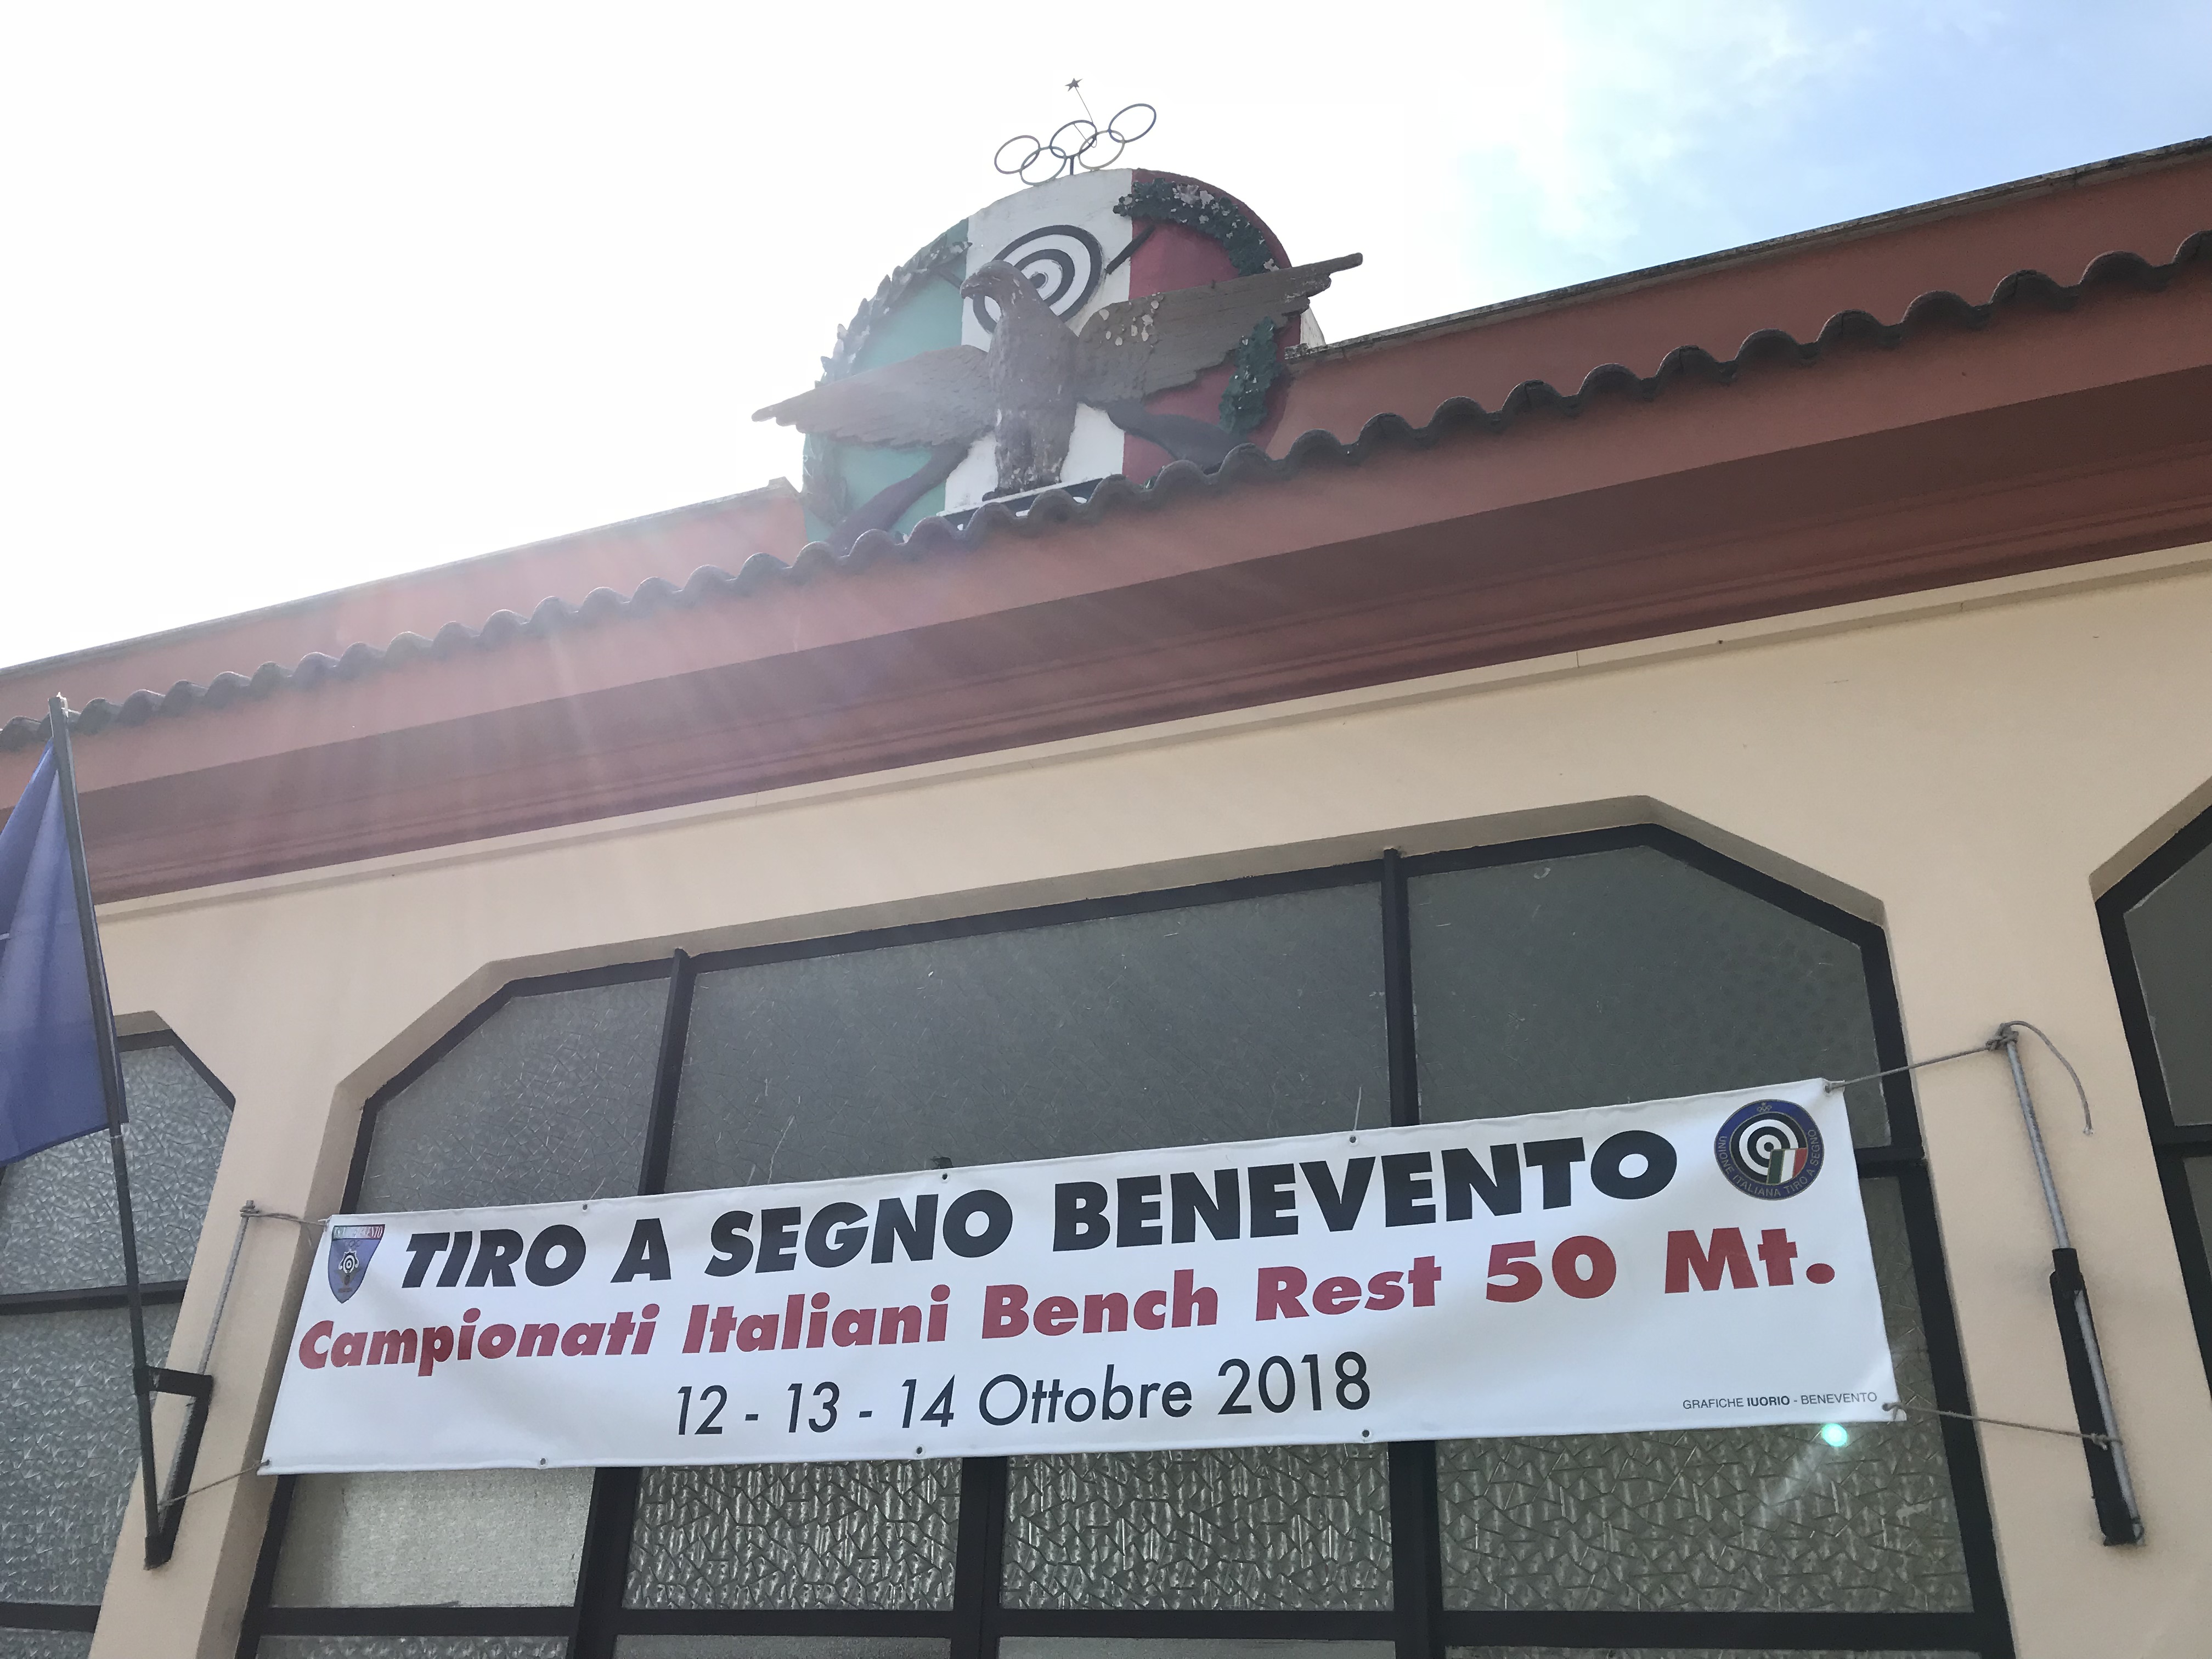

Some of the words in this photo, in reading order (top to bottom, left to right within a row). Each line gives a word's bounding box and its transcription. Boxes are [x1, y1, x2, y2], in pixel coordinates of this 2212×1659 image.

[1718, 1136, 1734, 1174] UNIONE
[1808, 1129, 1820, 1166] SEGNO
[1733, 1174, 1781, 1197] ITALIANA
[1784, 1176, 1808, 1195] TIRO
[1806, 1168, 1815, 1177] A
[402, 1224, 586, 1289] TIRO
[611, 1217, 671, 1283] A
[704, 1189, 1013, 1277] SEGNO
[1052, 1130, 1678, 1252] BENEVENTO
[298, 1304, 660, 1377] Campionati
[681, 1284, 951, 1354] Italiani
[981, 1268, 1218, 1339] Bench
[1255, 1255, 1442, 1322] Rest
[1486, 1235, 1617, 1303] 50
[1664, 1227, 1835, 1294] Mt.
[678, 1385, 727, 1435] 12
[787, 1381, 840, 1433] 13
[901, 1374, 955, 1429] 14
[979, 1364, 1192, 1426] Ottobre
[1217, 1351, 1370, 1415] 2018
[1683, 1397, 1744, 1409] GRAFICHE
[1747, 1395, 1790, 1407] IUORIO
[1801, 1391, 1877, 1405] BENEVENTO
